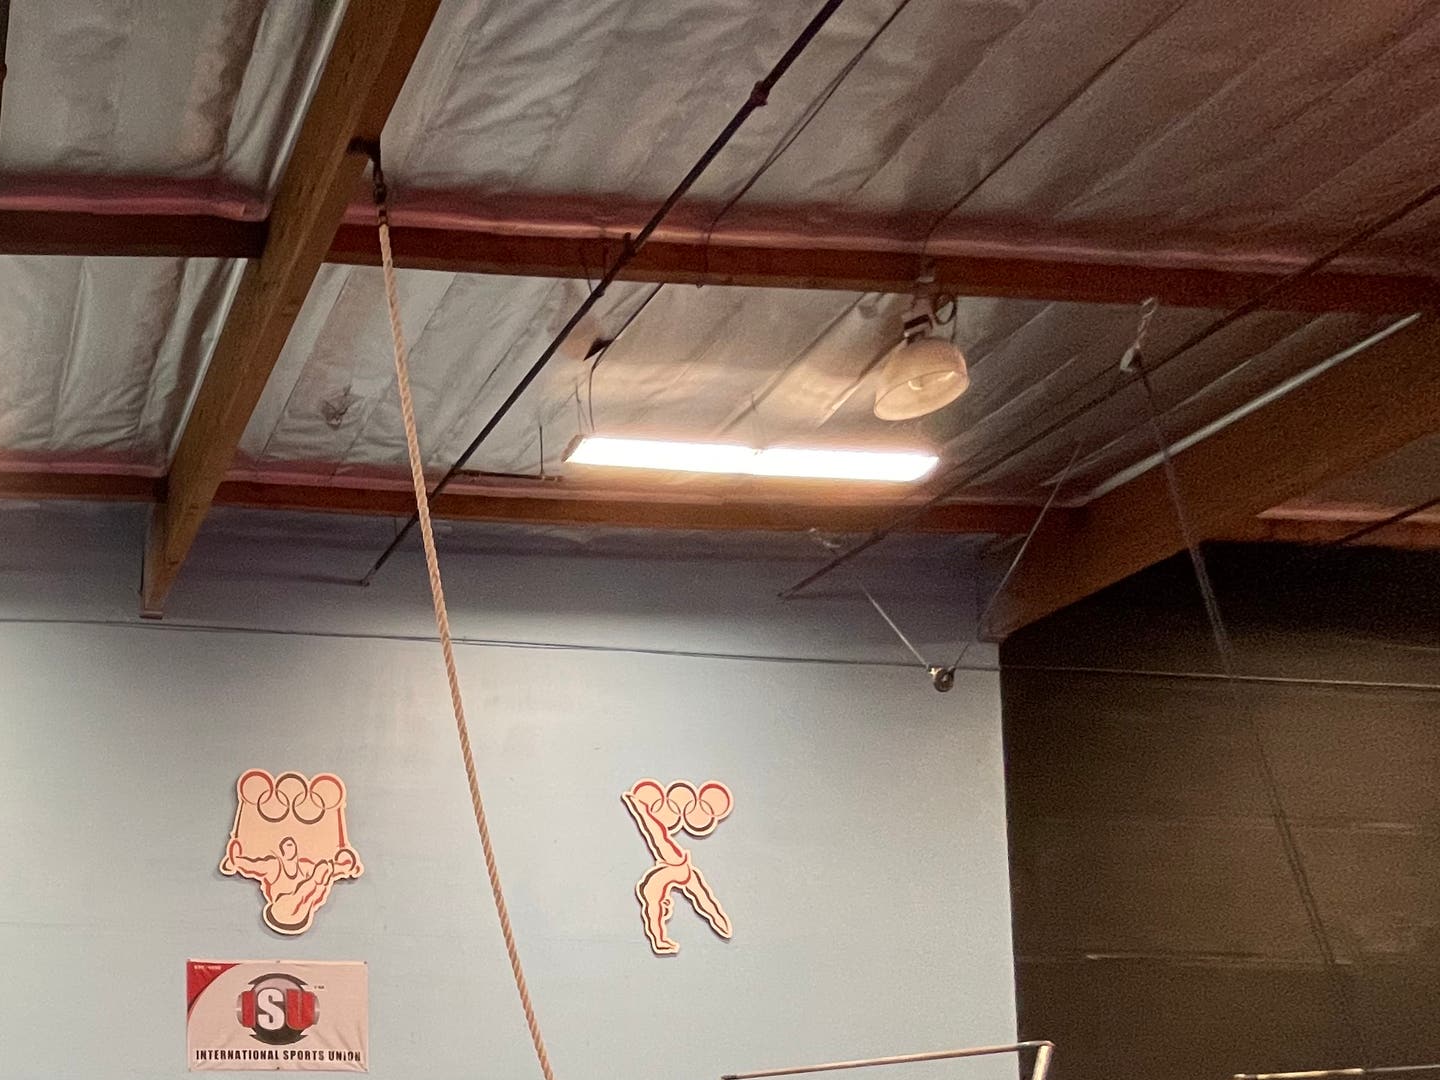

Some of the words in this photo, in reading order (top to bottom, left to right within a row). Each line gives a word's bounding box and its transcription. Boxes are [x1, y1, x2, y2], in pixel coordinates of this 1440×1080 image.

[241, 987, 316, 1031] ISU
[196, 1049, 279, 1061] INTERNATIONAL
[283, 1050, 325, 1062] SPORTS
[328, 1050, 361, 1062] UNION
